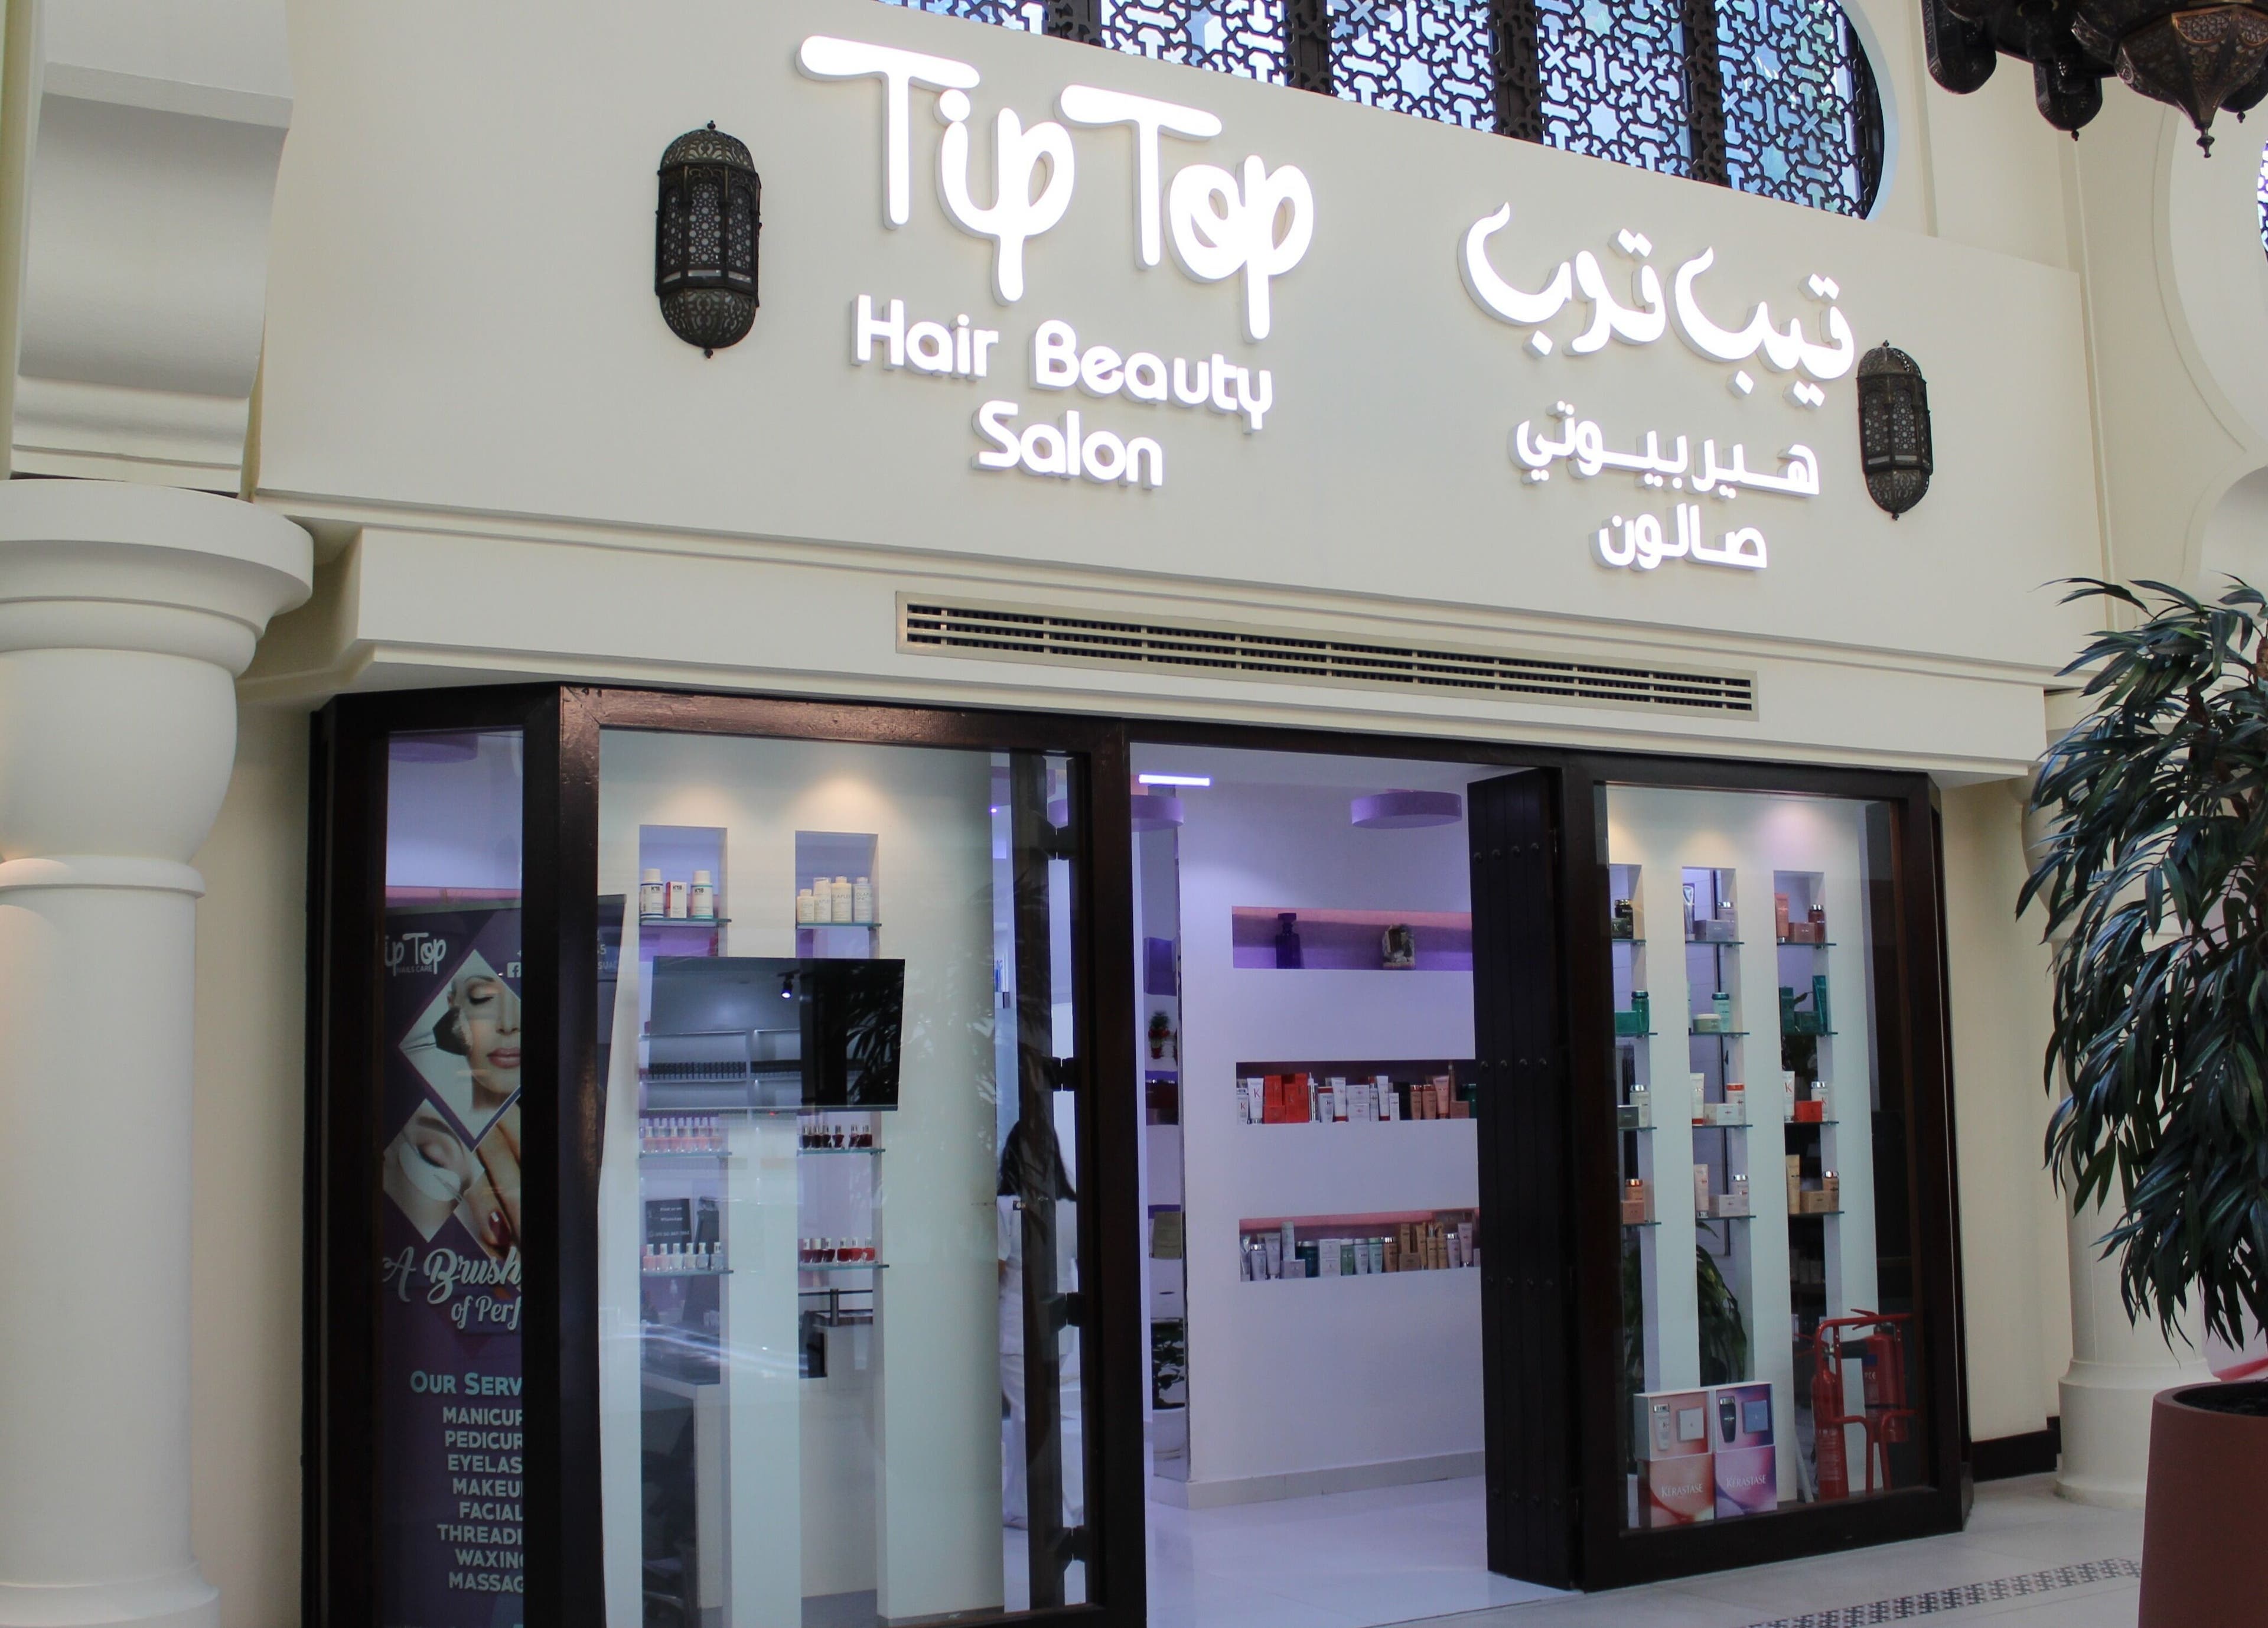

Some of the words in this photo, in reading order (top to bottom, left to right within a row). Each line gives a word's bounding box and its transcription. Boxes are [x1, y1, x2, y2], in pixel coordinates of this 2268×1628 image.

[796, 35, 1075, 304] Tip
[1056, 84, 1315, 343] Top
[850, 294, 999, 379] Hair
[1029, 320, 1273, 434] Beauty
[972, 400, 1163, 490] Salon
[1590, 503, 1768, 572] صالون
[402, 932, 447, 975] Top
[382, 1246, 416, 1303] A
[423, 1246, 522, 1305] Brush
[451, 1295, 473, 1330] of
[410, 1370, 457, 1394] OUR
[464, 1372, 522, 1396] SERV
[447, 1454, 523, 1475] EYELAS
[452, 1478, 523, 1499] MAKEU
[459, 1502, 523, 1522] FACIAL
[454, 1548, 523, 1569] WAXIN
[449, 1571, 524, 1594] MASSAG
